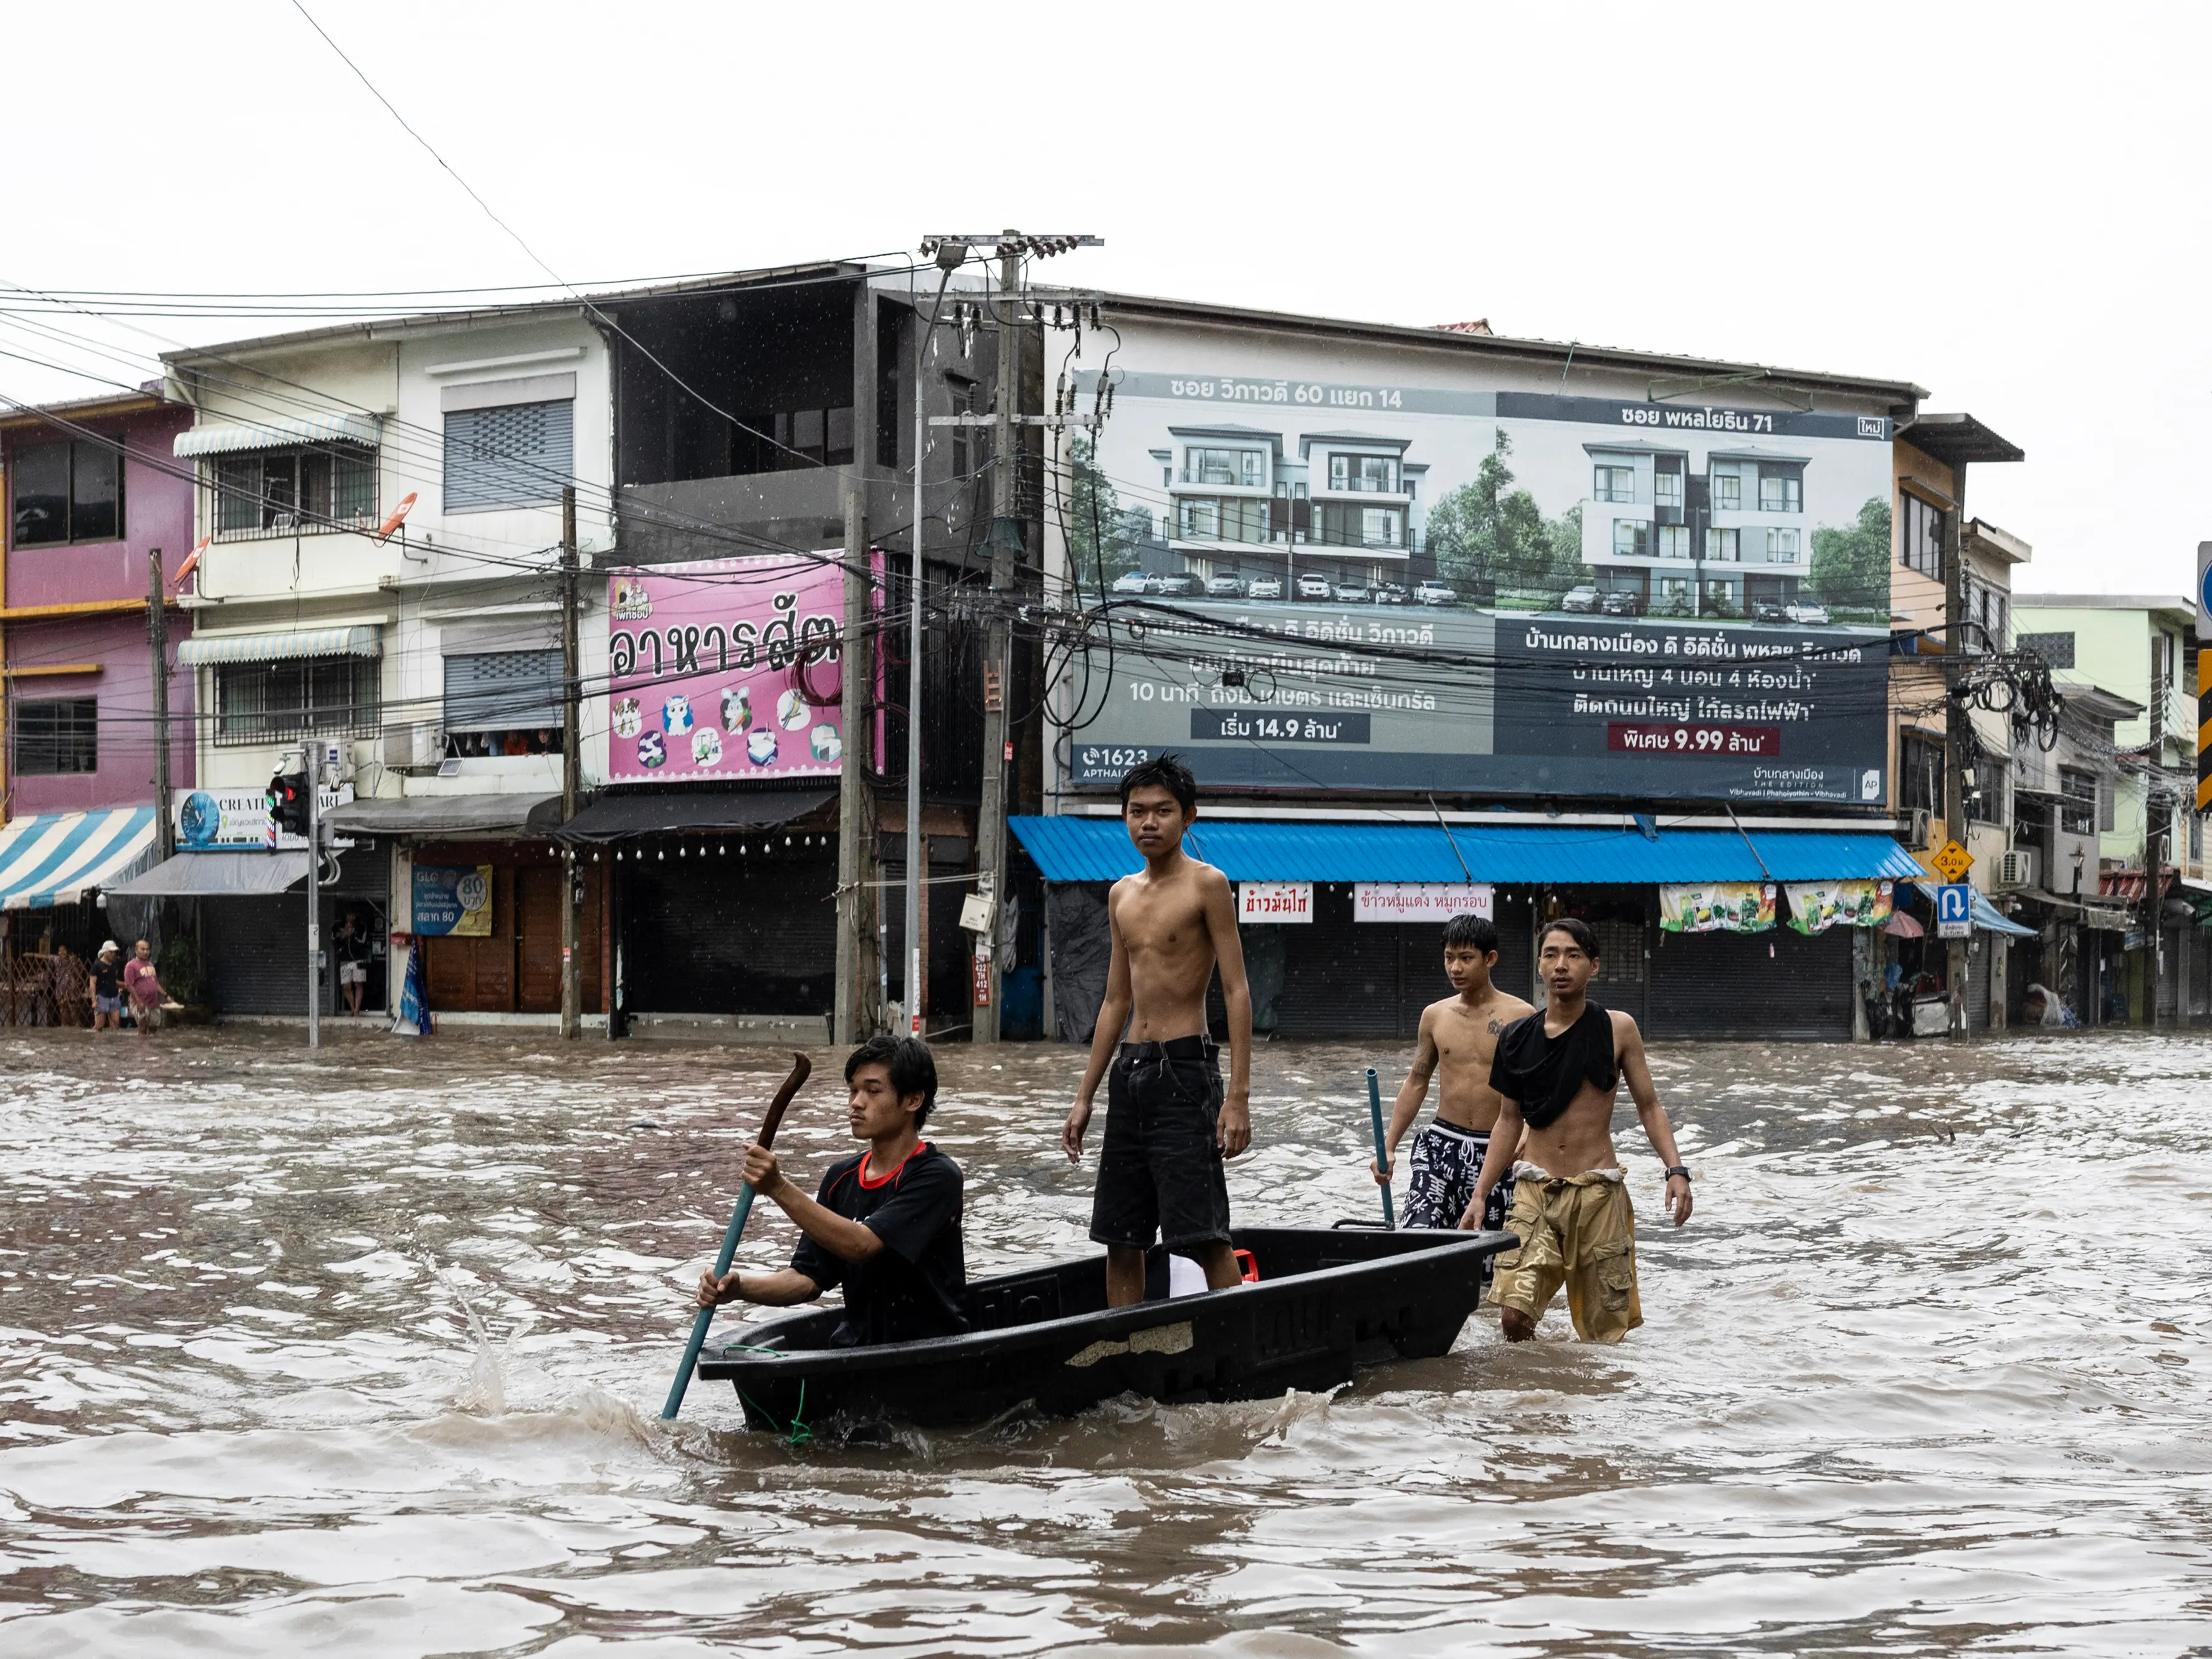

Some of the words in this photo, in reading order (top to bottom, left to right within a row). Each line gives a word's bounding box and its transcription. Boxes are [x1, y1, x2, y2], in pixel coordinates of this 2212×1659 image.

[1171, 379, 1214, 397] ซอย
[1221, 379, 1288, 402] วิภาวดี
[1294, 384, 1323, 404] 60
[1330, 389, 1372, 407] แยก
[1378, 389, 1403, 409] 14
[1622, 408, 1660, 425] ซอย
[1666, 407, 1748, 430] พหลโยธิน
[1753, 414, 1773, 432] 71
[1861, 419, 1881, 434] ใหม่
[609, 591, 844, 678] อาหารสัต
[1368, 622, 1434, 645] วิภาวดี
[1526, 626, 1659, 654] บ้านกลางเมือง
[1664, 635, 1678, 655] ดิ
[1684, 630, 1736, 658] อิดิชั่น
[1660, 668, 1674, 685] 4
[1680, 669, 1722, 687] นอน
[1728, 670, 1741, 687] 4
[1129, 682, 1155, 701] 10
[1573, 693, 1690, 722] ติดถนนใหญ่
[1221, 711, 1251, 736] เริ่ม
[1256, 718, 1299, 738] 14.9
[1623, 729, 1670, 749] พิเศษ
[1674, 728, 1724, 751] 9.99
[1102, 748, 1148, 766] 1623
[1753, 766, 1824, 781] บ้านกลางเมือง
[1729, 788, 1762, 797] Vibhavadi
[1766, 789, 1809, 799] Phaholyothin
[1814, 790, 1847, 799] Vibhavadi
[1753, 780, 1773, 788] THE
[1780, 781, 1824, 789] EDITION
[1864, 780, 1878, 789] AP
[462, 876, 483, 895] 80
[1246, 888, 1307, 915] ข้าวมันไก
[1361, 890, 1430, 914] ข้าวหมูแดง
[1434, 895, 1488, 914] หมูกรอบ
[417, 911, 440, 922] สลาก
[442, 910, 455, 923] 80
[975, 964, 986, 972] 422
[976, 980, 988, 989] 412
